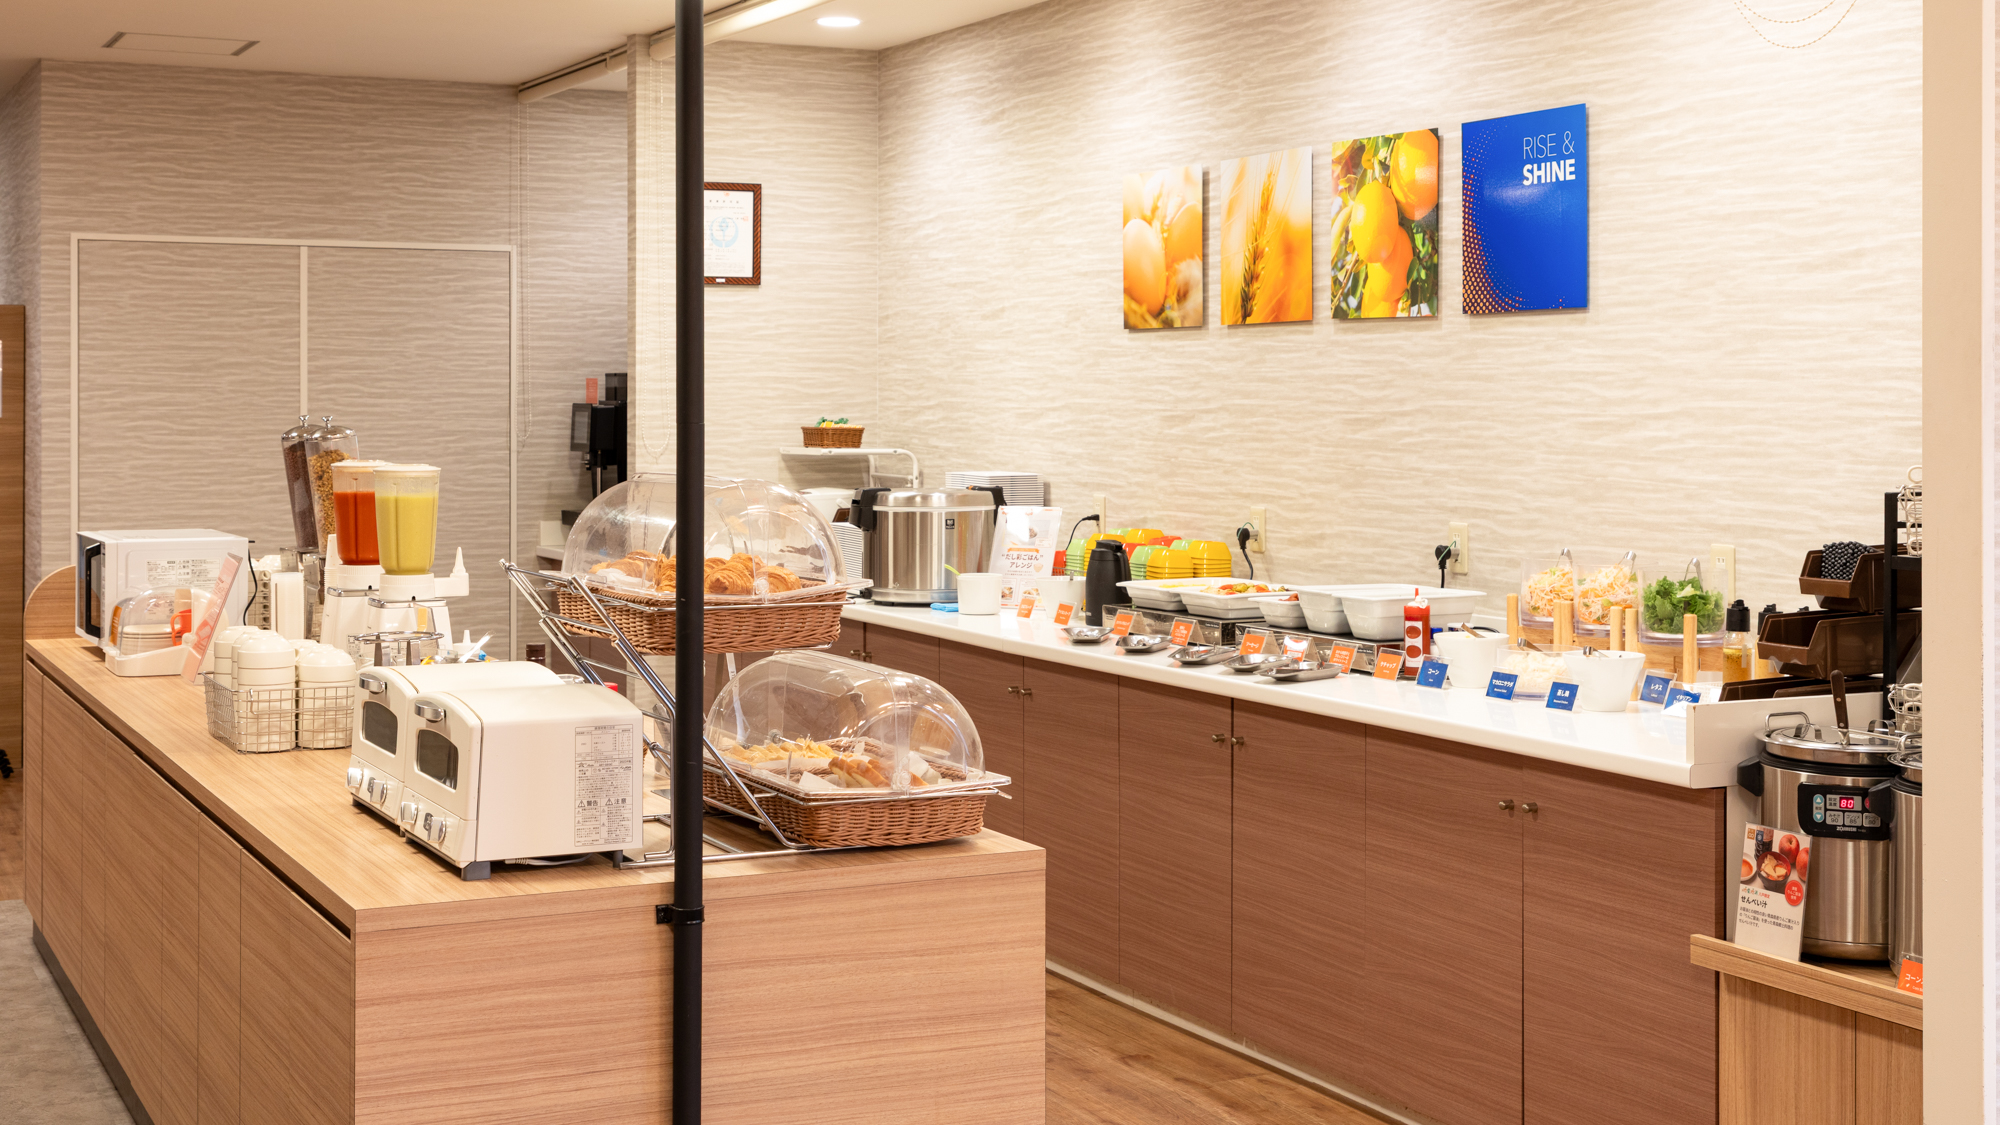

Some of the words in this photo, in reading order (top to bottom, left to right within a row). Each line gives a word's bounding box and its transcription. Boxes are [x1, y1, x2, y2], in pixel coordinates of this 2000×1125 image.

[1523, 133, 1557, 160] RISE
[1562, 130, 1575, 155] &
[1522, 158, 1576, 185] SHINE
[1380, 661, 1397, 669] ケチャップ
[1650, 683, 1663, 691] レタス
[1675, 694, 1693, 702] イタリアン
[1840, 799, 1854, 808] 80
[1740, 895, 1767, 908] せんべい汁
[1905, 973, 1923, 984] コーン
